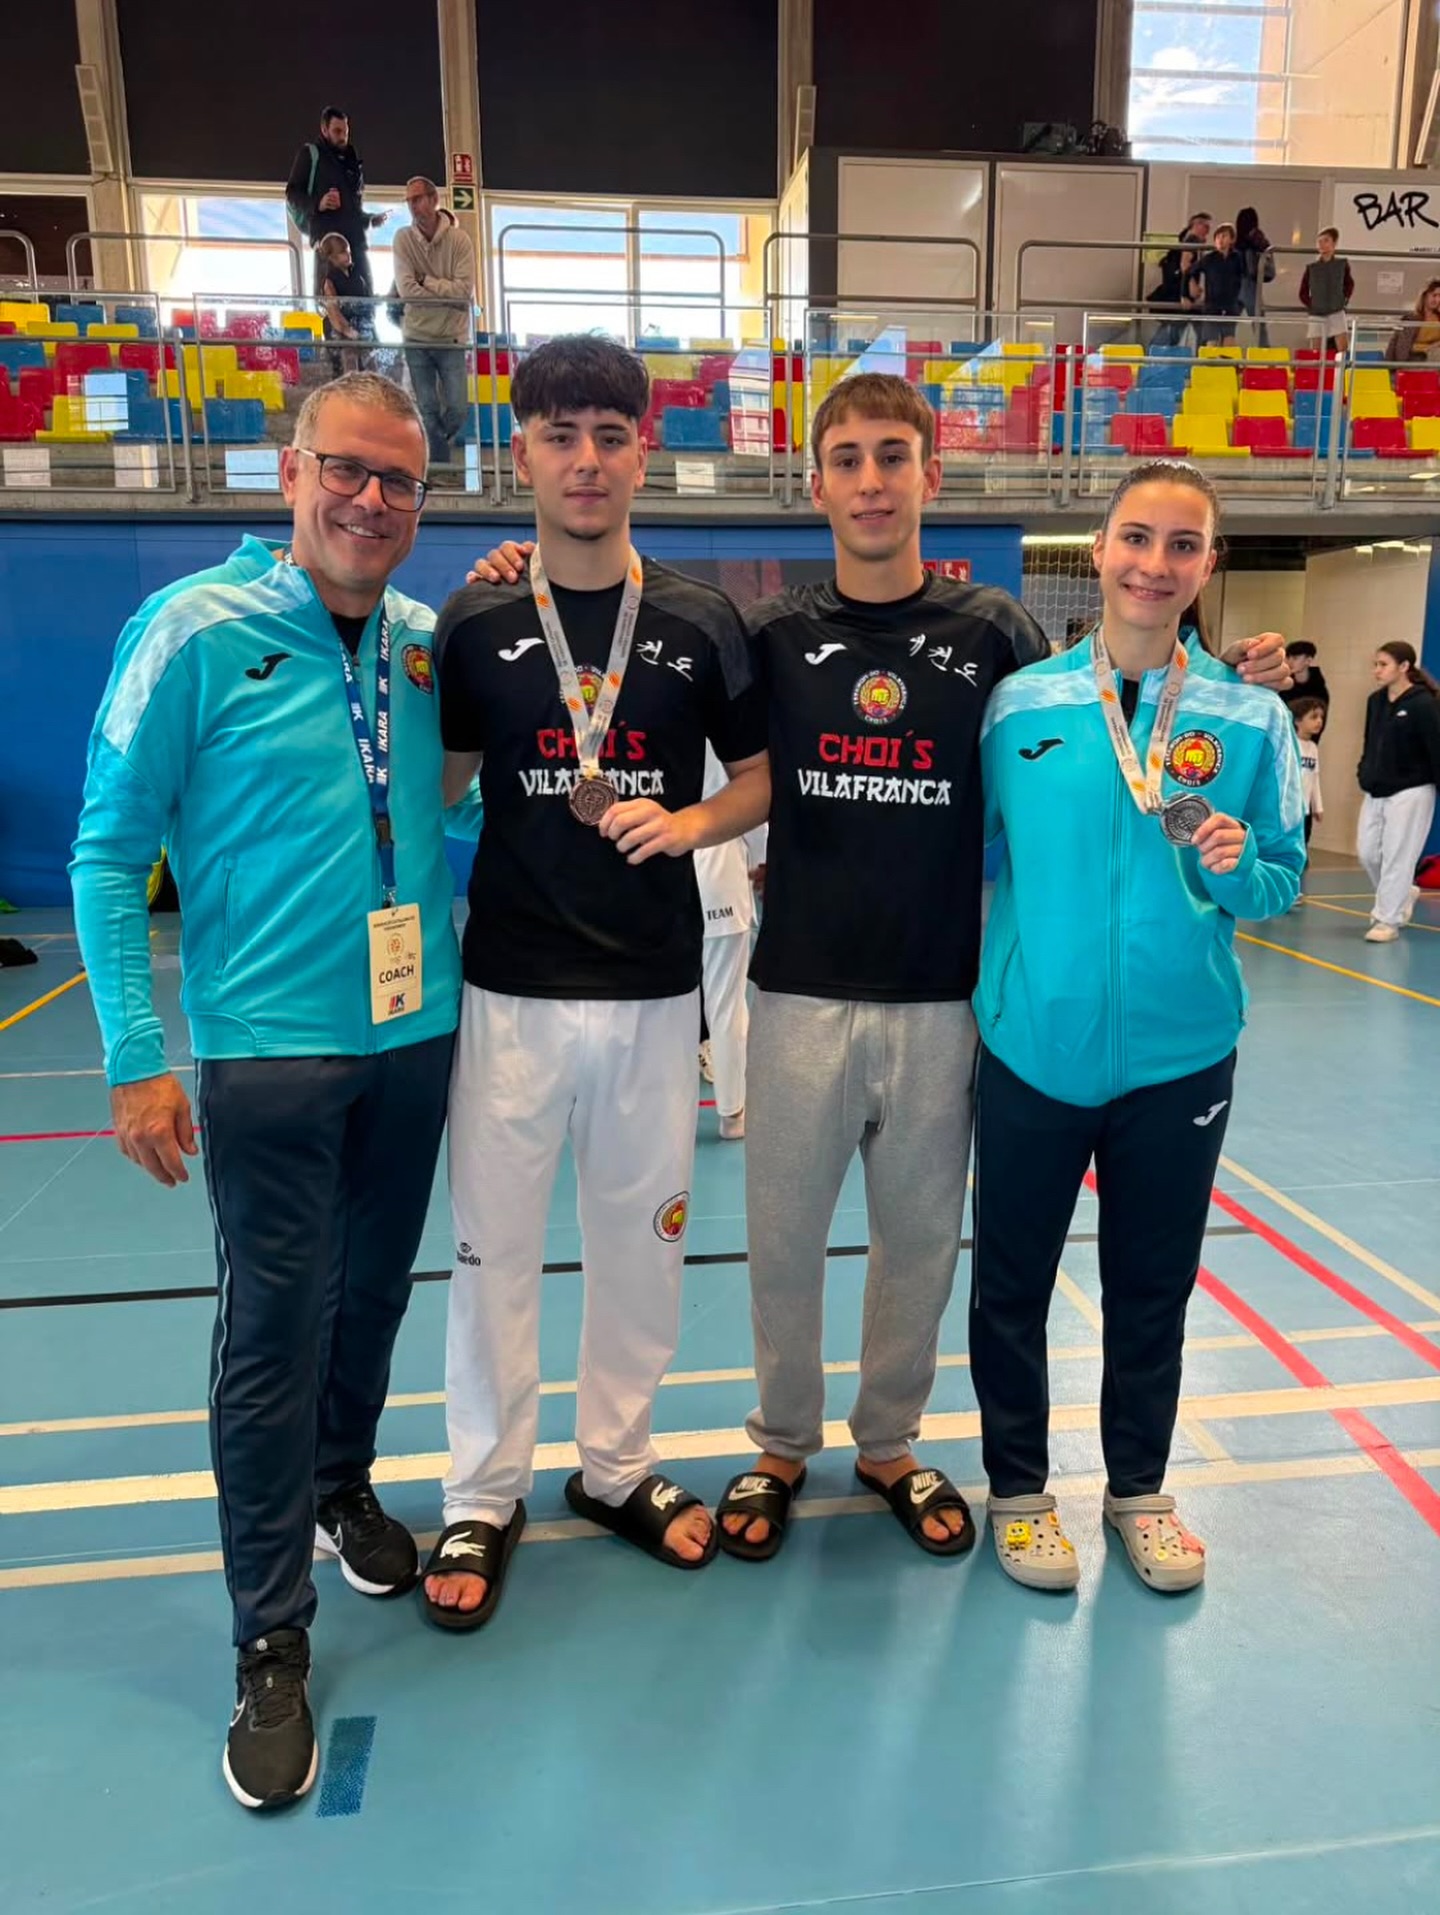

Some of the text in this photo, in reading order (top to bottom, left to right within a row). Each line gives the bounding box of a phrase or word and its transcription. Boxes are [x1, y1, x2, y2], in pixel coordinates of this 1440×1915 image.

[1353, 190, 1439, 231] BAR
[377, 710, 388, 753] IKARA
[536, 721, 647, 761] CHI´S
[518, 767, 665, 797] VILAANCA
[797, 768, 952, 806] VILAFRANCA
[706, 905, 734, 921] TEAM
[378, 964, 414, 984] COACH
[740, 1475, 771, 1491] NIKE
[911, 1470, 940, 1491] NIKE
